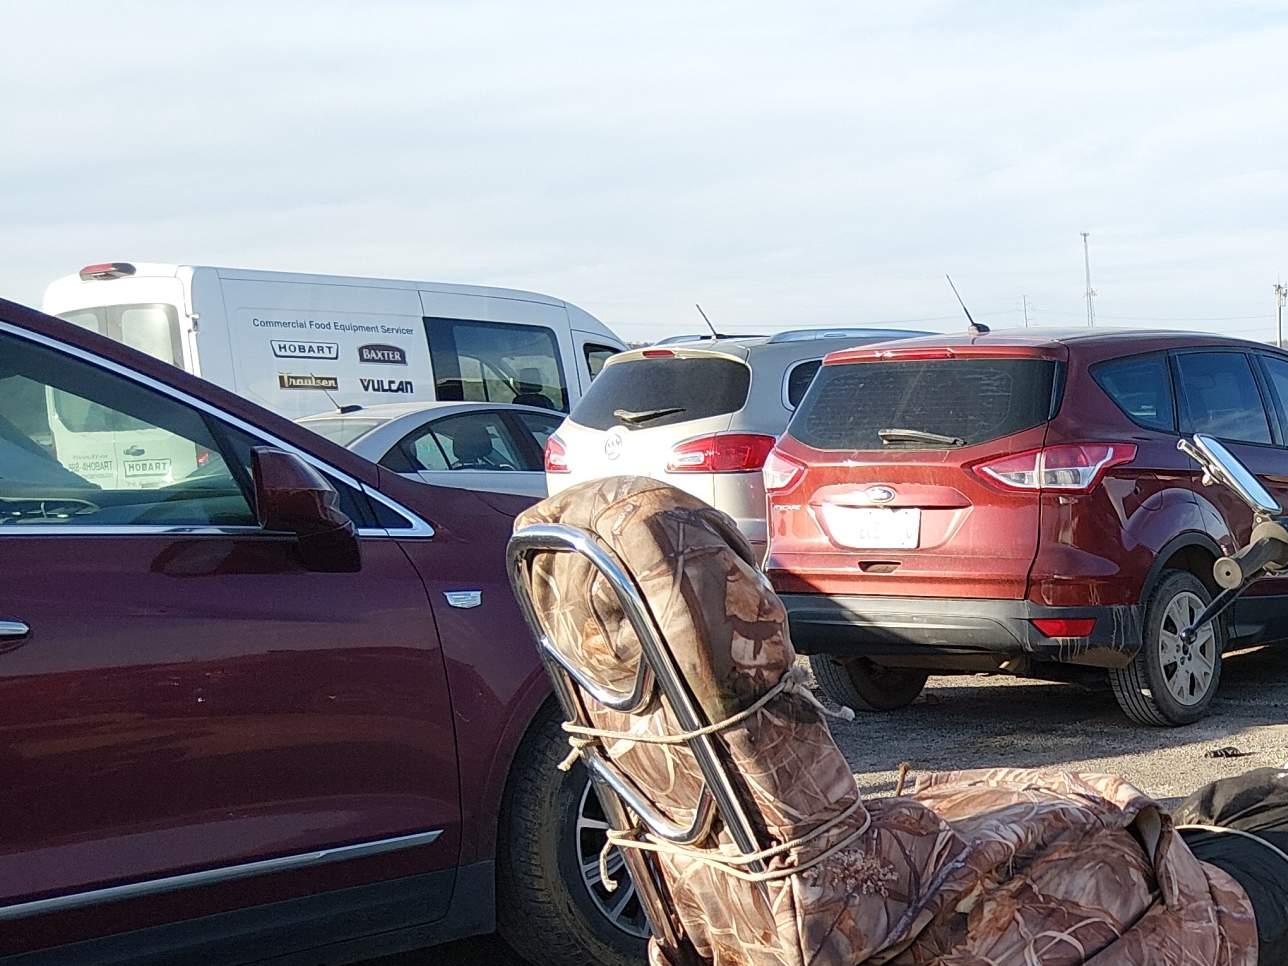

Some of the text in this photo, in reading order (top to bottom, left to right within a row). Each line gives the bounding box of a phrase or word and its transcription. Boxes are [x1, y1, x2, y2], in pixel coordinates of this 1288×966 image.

[252, 318, 414, 335] Commercial Food Equipment Servicer
[278, 344, 334, 355] HOBART
[362, 348, 402, 361] BAXTER
[359, 378, 414, 394] VULCAN
[128, 462, 168, 472] HOBART
